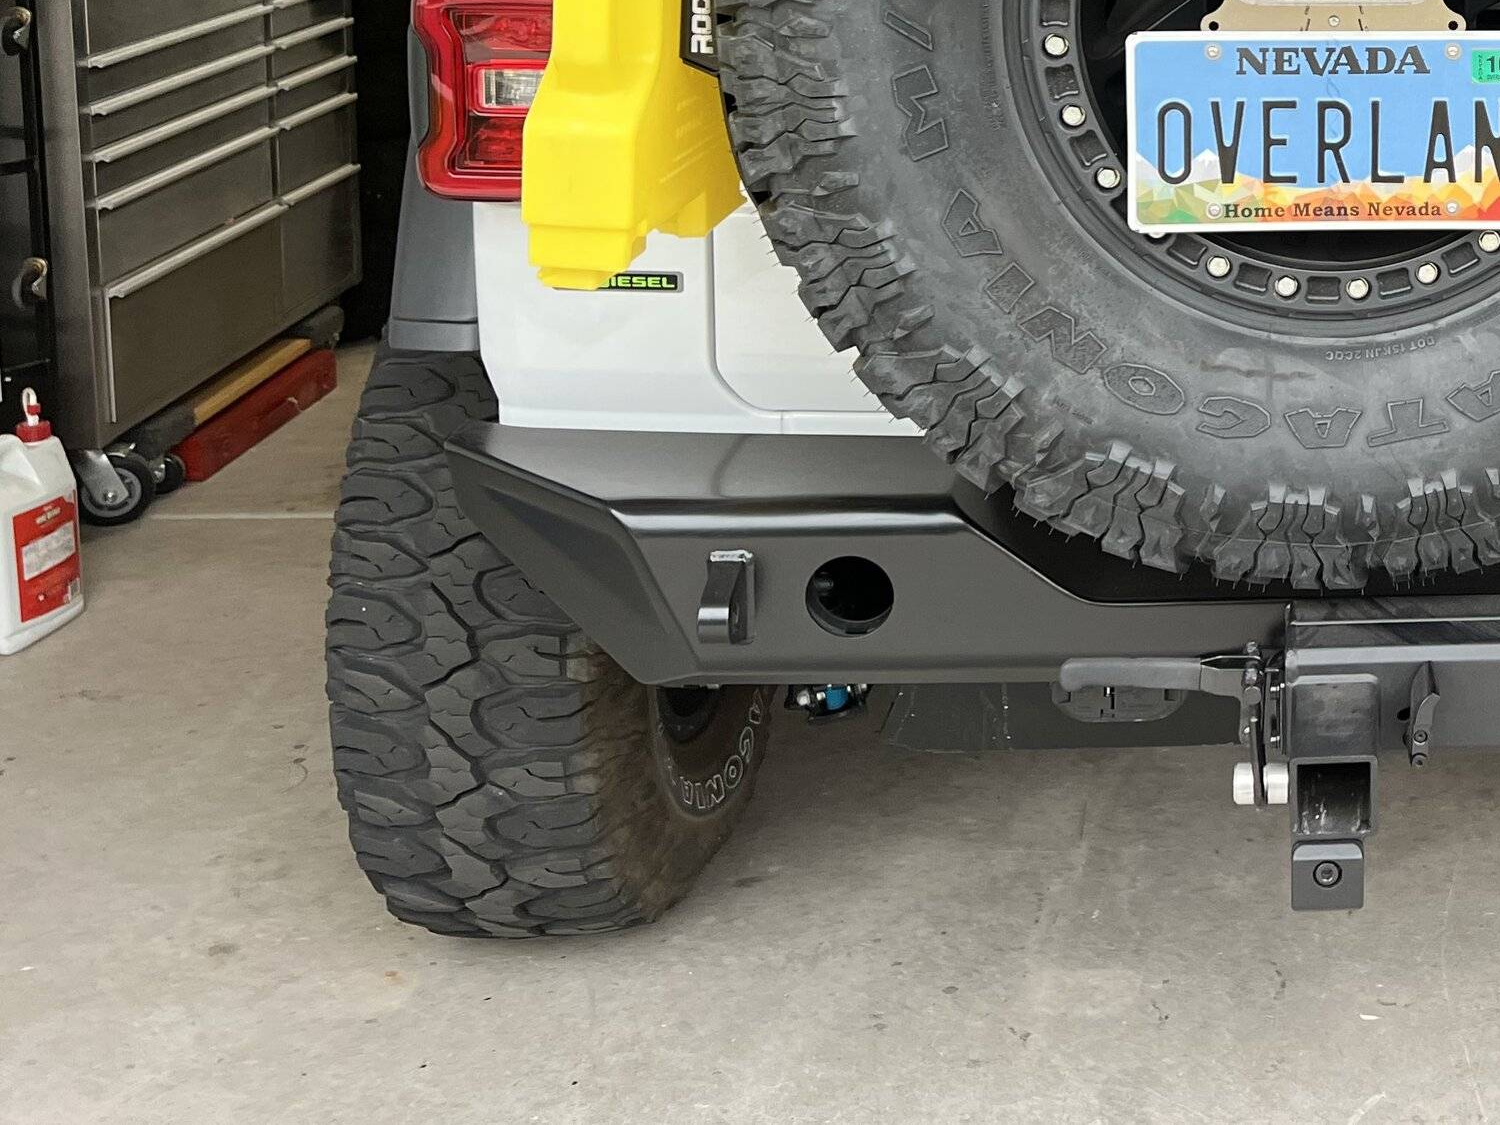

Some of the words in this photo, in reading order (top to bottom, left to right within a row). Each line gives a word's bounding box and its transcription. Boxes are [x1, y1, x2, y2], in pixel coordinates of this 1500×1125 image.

[1235, 45, 1430, 76] NEVADA
[1224, 203, 1285, 218] Home
[1293, 203, 1358, 218] Means
[1367, 202, 1443, 217] Nevada
